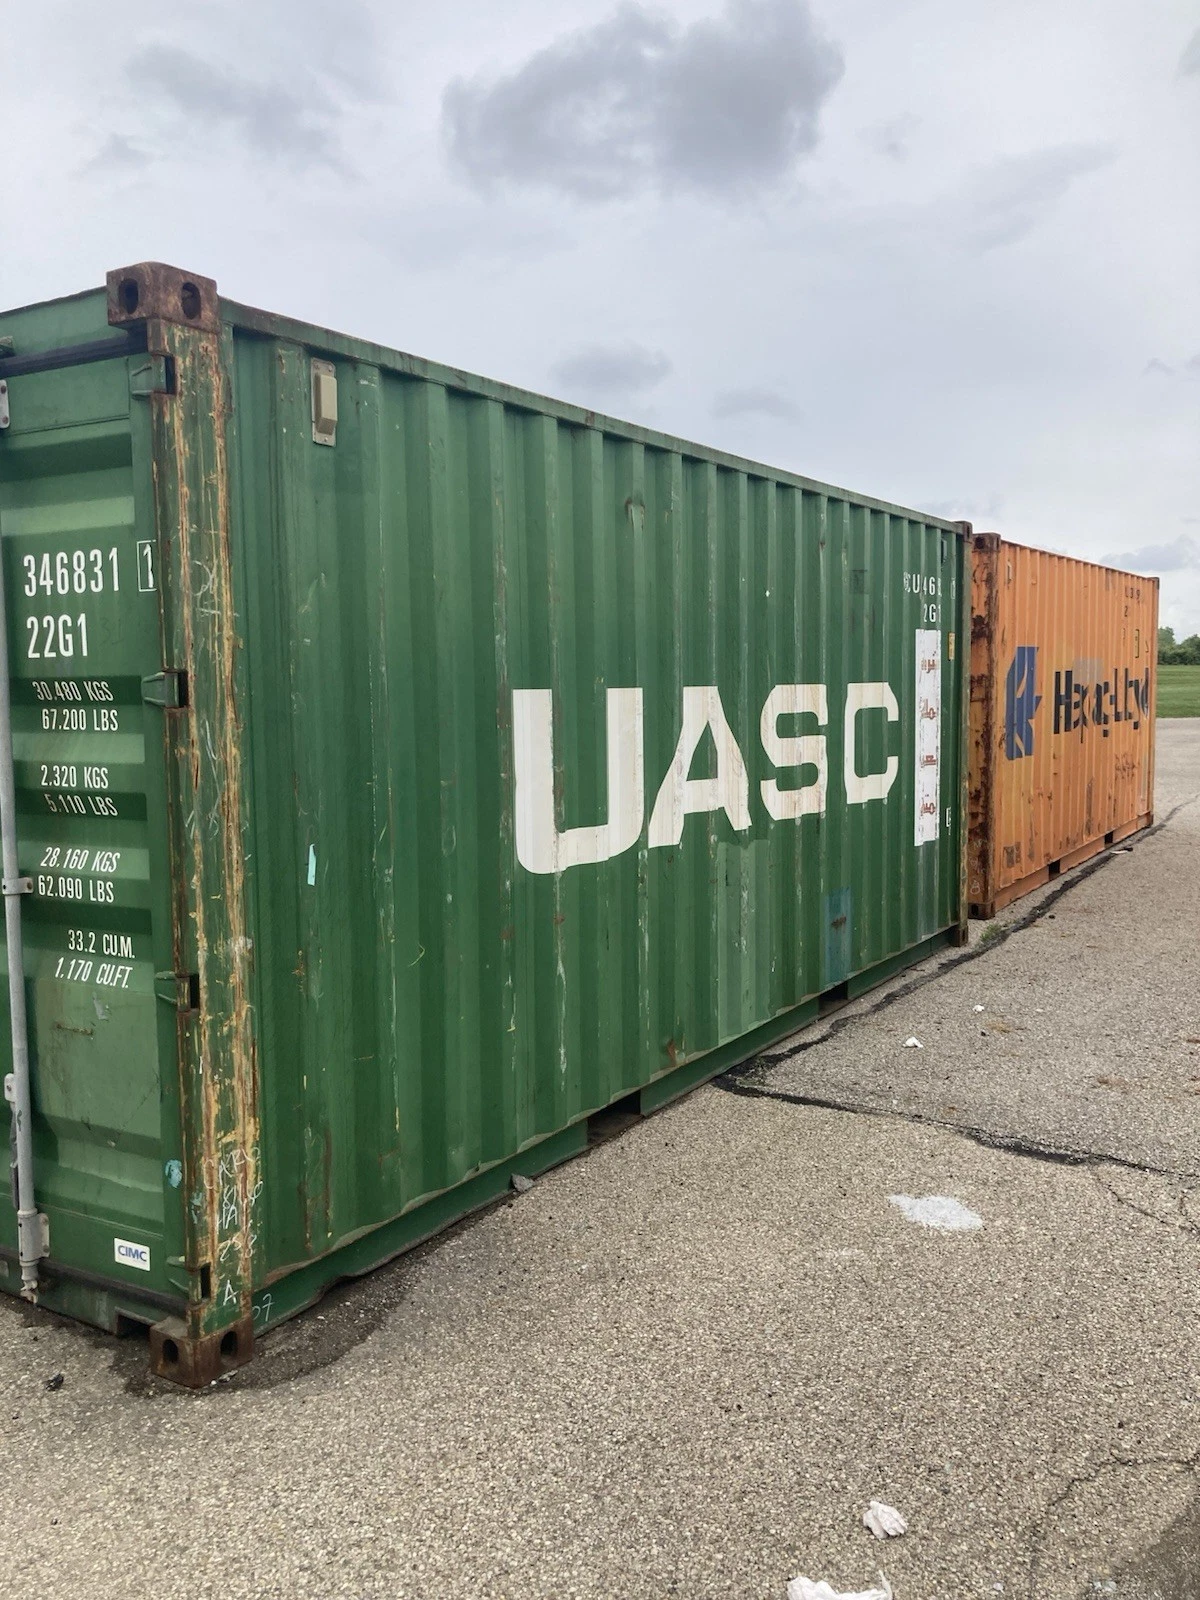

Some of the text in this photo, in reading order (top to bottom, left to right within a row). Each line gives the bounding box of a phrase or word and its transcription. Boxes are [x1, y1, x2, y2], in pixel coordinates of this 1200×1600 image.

[23, 547, 119, 597] 346831
[26, 613, 88, 658] 22G1
[32, 681, 114, 702] 30.480 KGS
[42, 708, 118, 731] 67.200 LBS
[84, 766, 109, 789] KGS
[512, 682, 900, 874] UASC
[87, 796, 119, 816] LBS
[91, 851, 121, 873] KGS
[38, 875, 114, 903] 62.090 LBS
[68, 929, 136, 959] 33.2 CU.M.
[117, 1245, 148, 1263] CIMC
